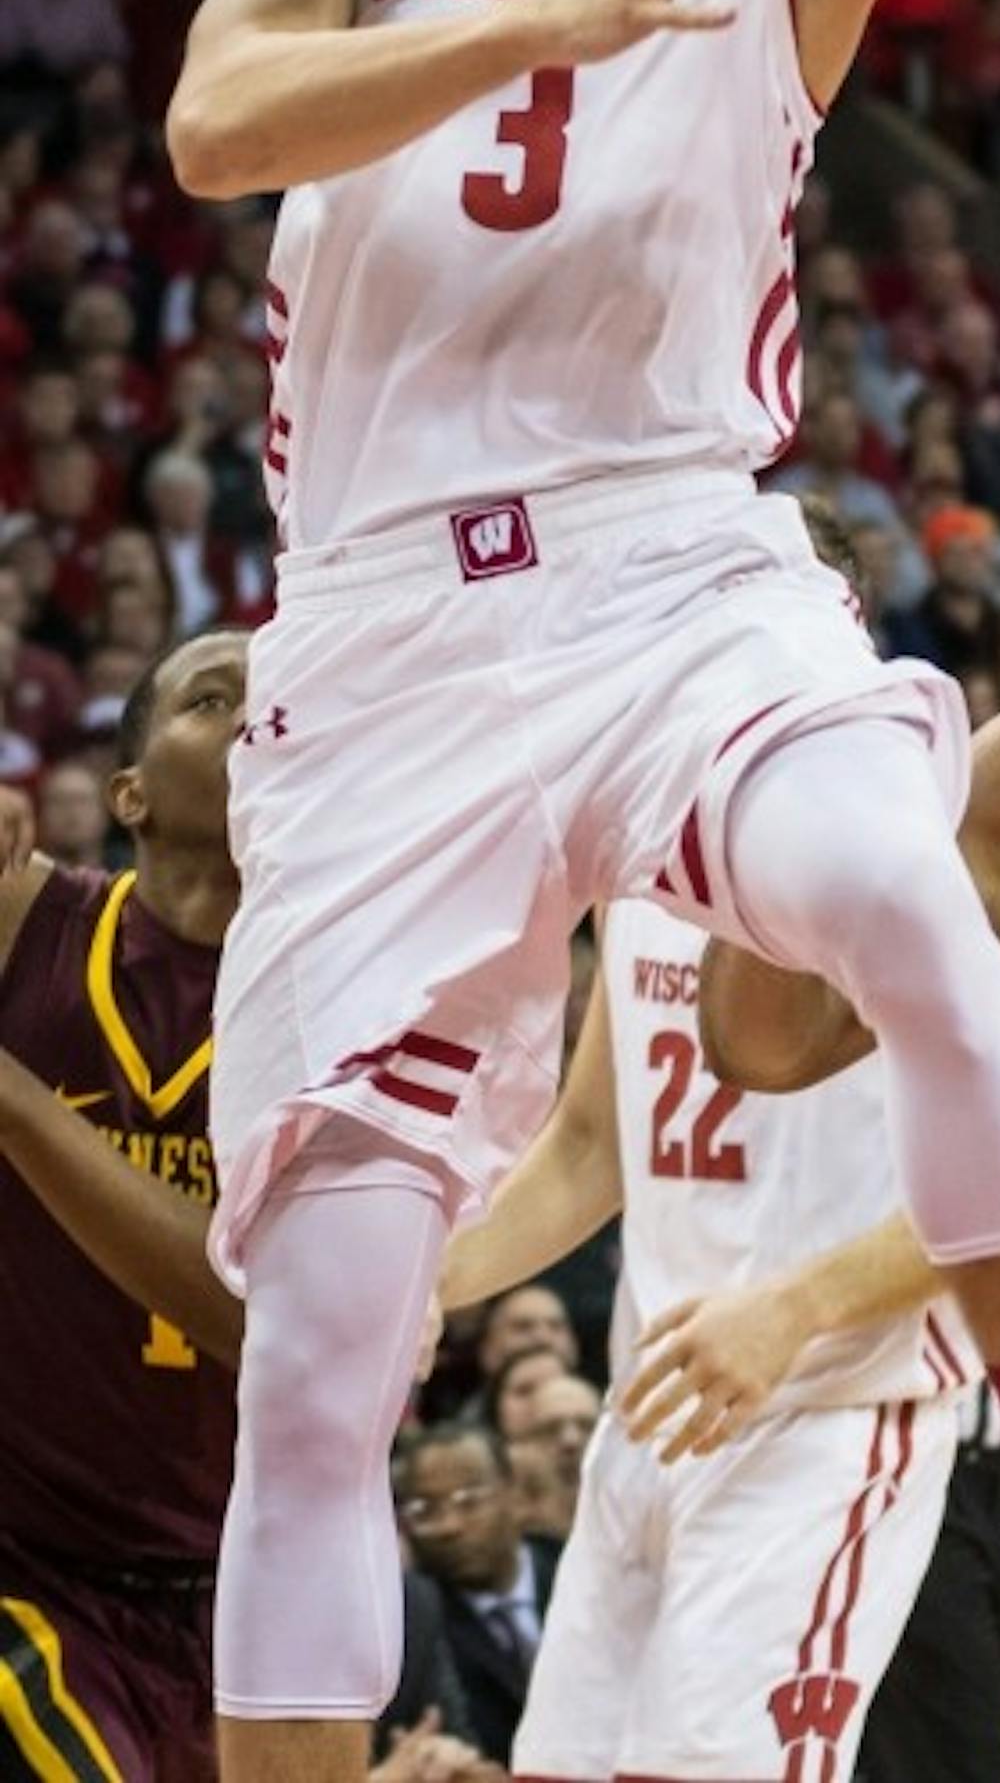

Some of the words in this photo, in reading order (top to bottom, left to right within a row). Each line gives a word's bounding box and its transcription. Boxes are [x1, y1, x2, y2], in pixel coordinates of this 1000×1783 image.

[461, 64, 575, 232] 3
[633, 956, 699, 1006] WISC
[648, 1030, 747, 1184] 22
